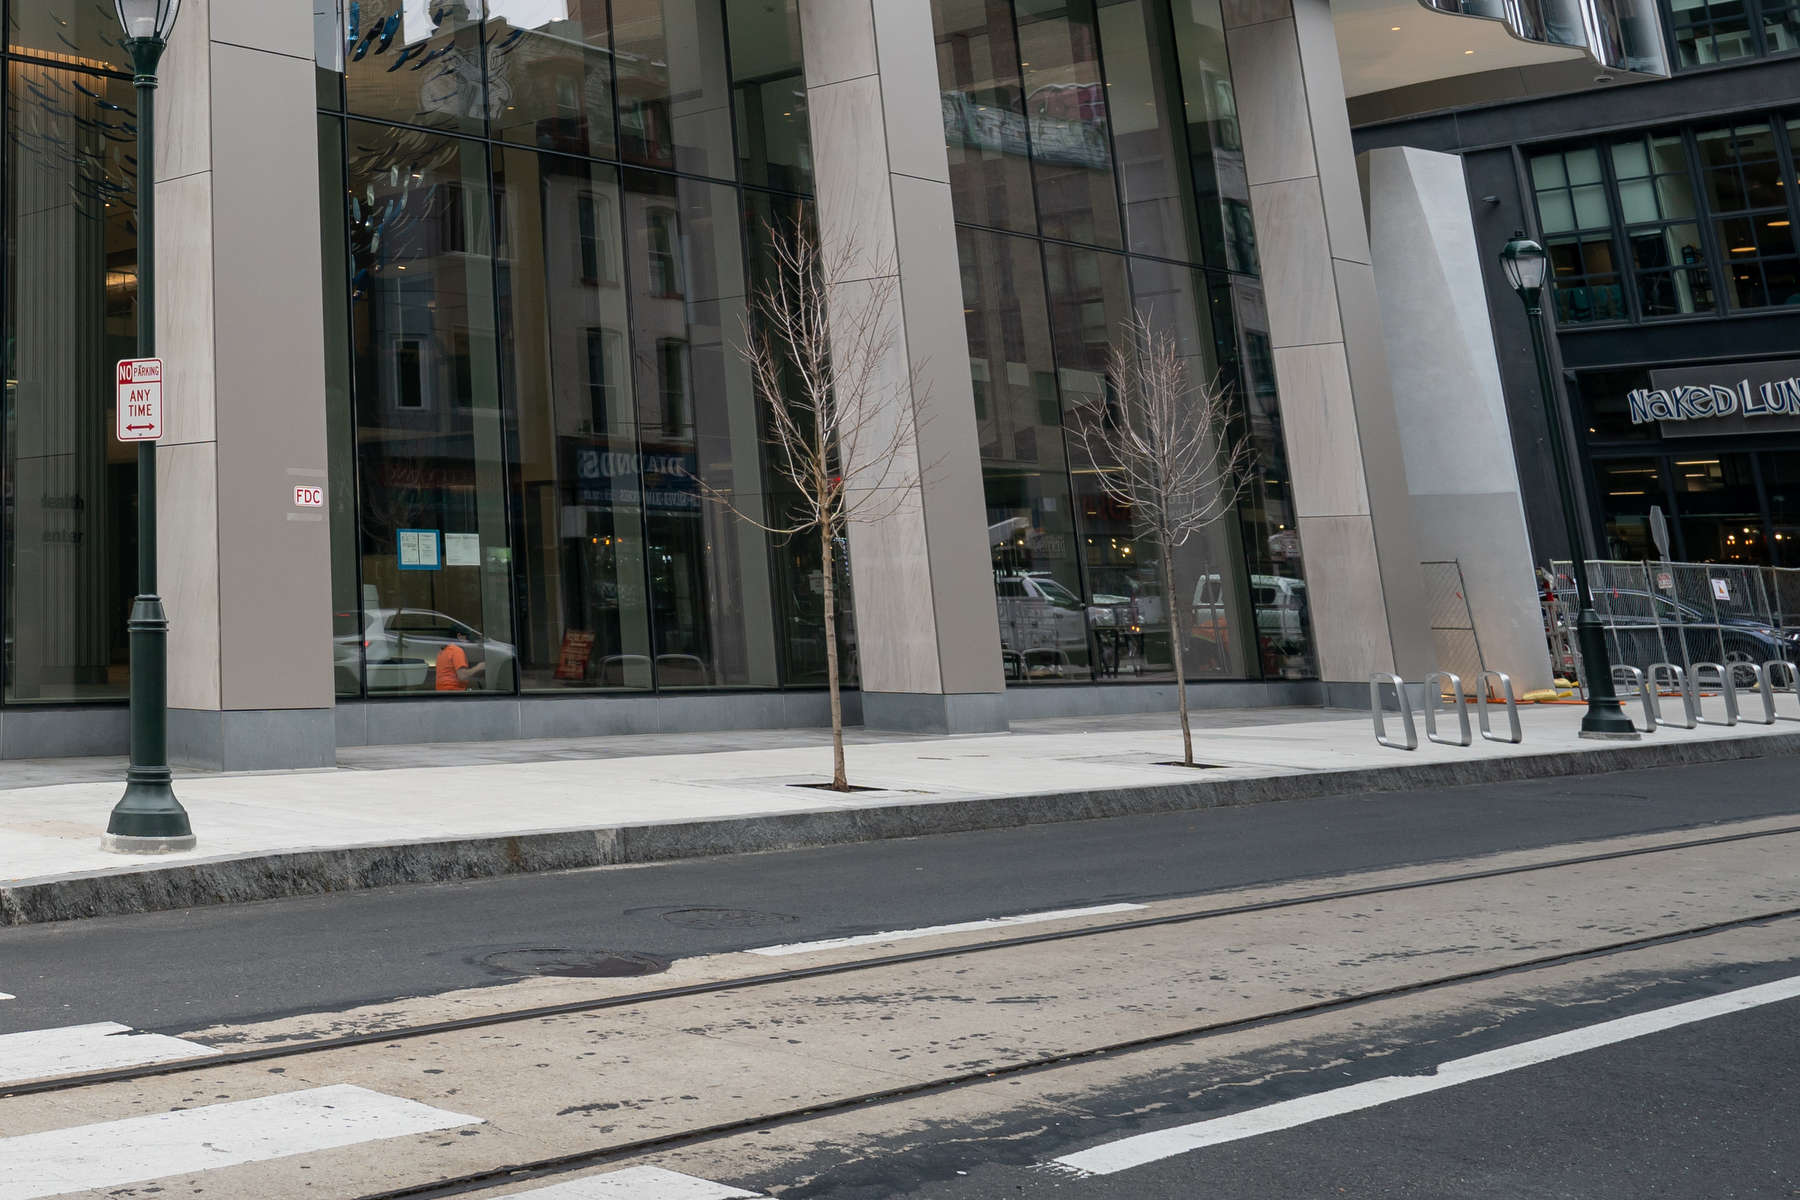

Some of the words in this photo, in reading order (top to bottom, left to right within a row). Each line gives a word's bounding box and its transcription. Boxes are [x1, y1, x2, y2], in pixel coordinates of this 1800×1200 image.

[120, 365, 132, 380] NO
[134, 366, 159, 377] PARKING
[130, 389, 150, 402] ANY
[129, 404, 152, 417] TIME
[297, 489, 320, 503] FDC
[41, 530, 84, 543] enter
